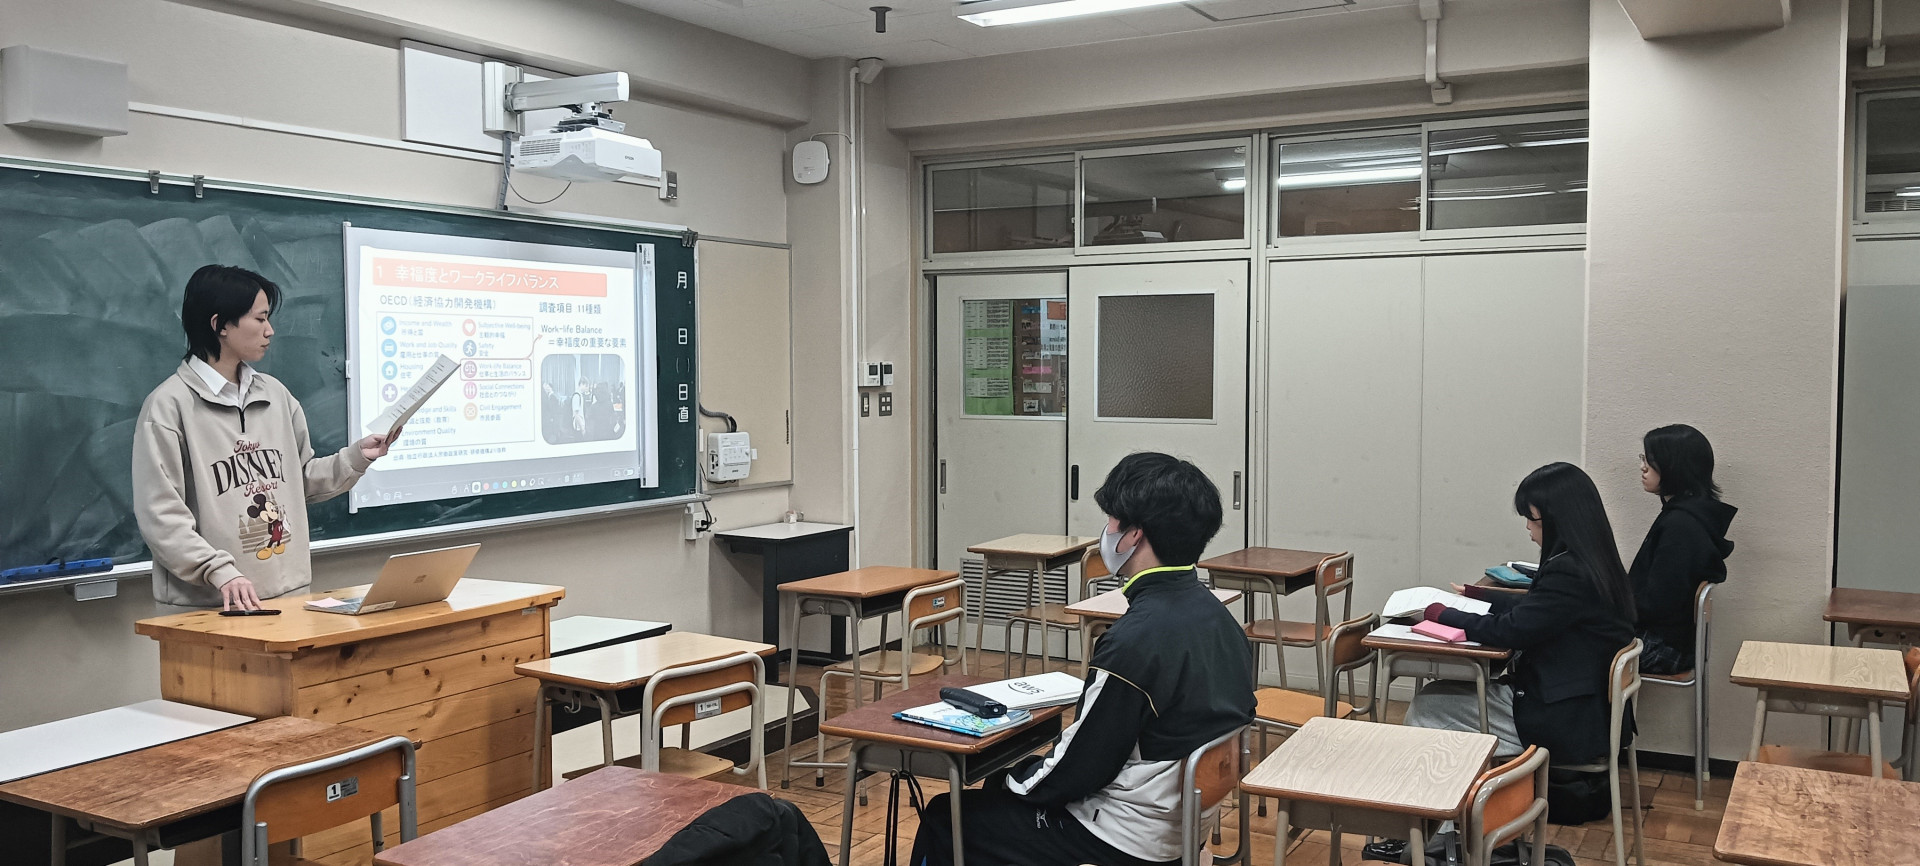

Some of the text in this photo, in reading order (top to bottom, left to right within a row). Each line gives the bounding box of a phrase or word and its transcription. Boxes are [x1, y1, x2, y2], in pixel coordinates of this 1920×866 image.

[376, 265, 560, 289] 1 幸福度とワークライフバランス
[677, 271, 688, 289] 月
[539, 301, 602, 316] 調査項目 11種類
[541, 324, 603, 335] Work-life Balance
[678, 328, 688, 345] 日
[234, 440, 261, 454] Tokyo
[244, 481, 278, 498] Resort
[331, 785, 337, 795] 1
